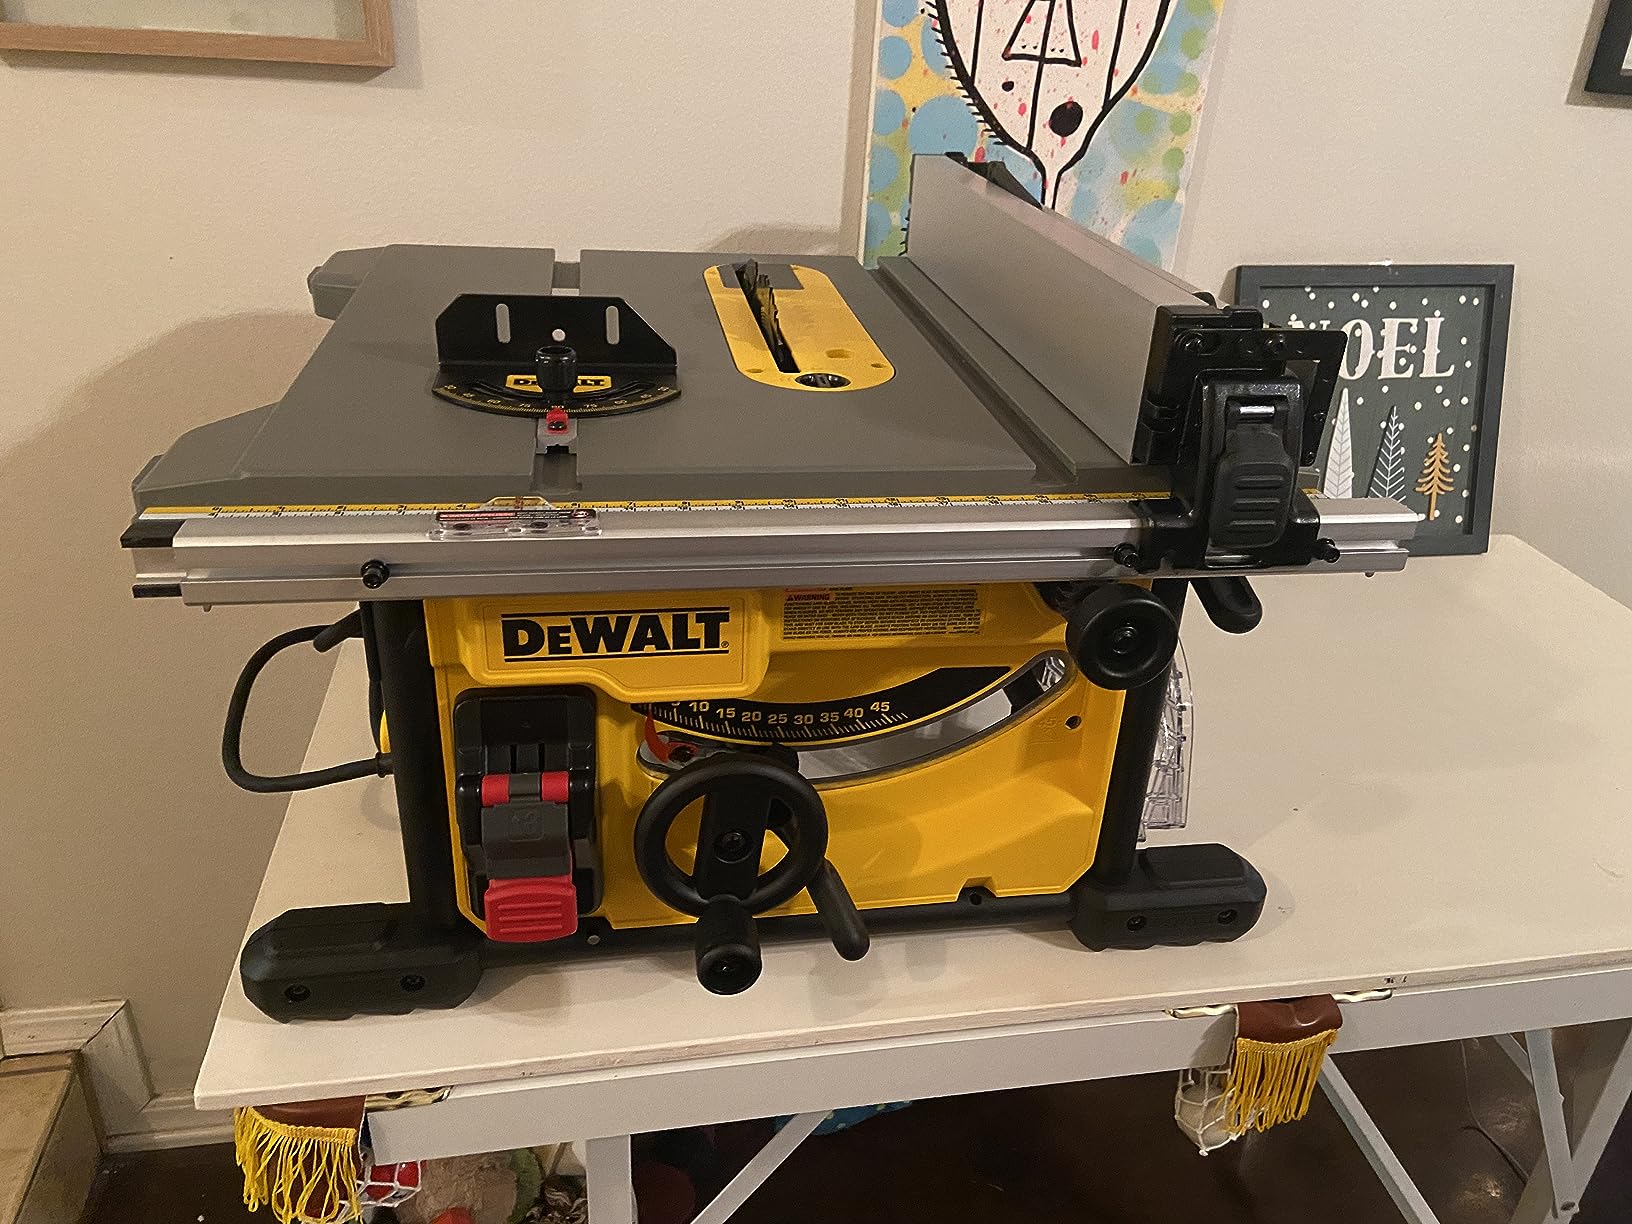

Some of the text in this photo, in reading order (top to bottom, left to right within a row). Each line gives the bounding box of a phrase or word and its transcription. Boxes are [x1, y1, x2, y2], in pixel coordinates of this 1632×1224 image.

[1288, 316, 1455, 380] OEL
[688, 701, 710, 713] 10
[715, 707, 736, 719] 15
[741, 711, 763, 722] 20
[767, 713, 788, 725] 25
[793, 714, 814, 725] 30
[819, 712, 840, 723] 35
[843, 707, 864, 719] 40
[870, 701, 891, 712] 45
